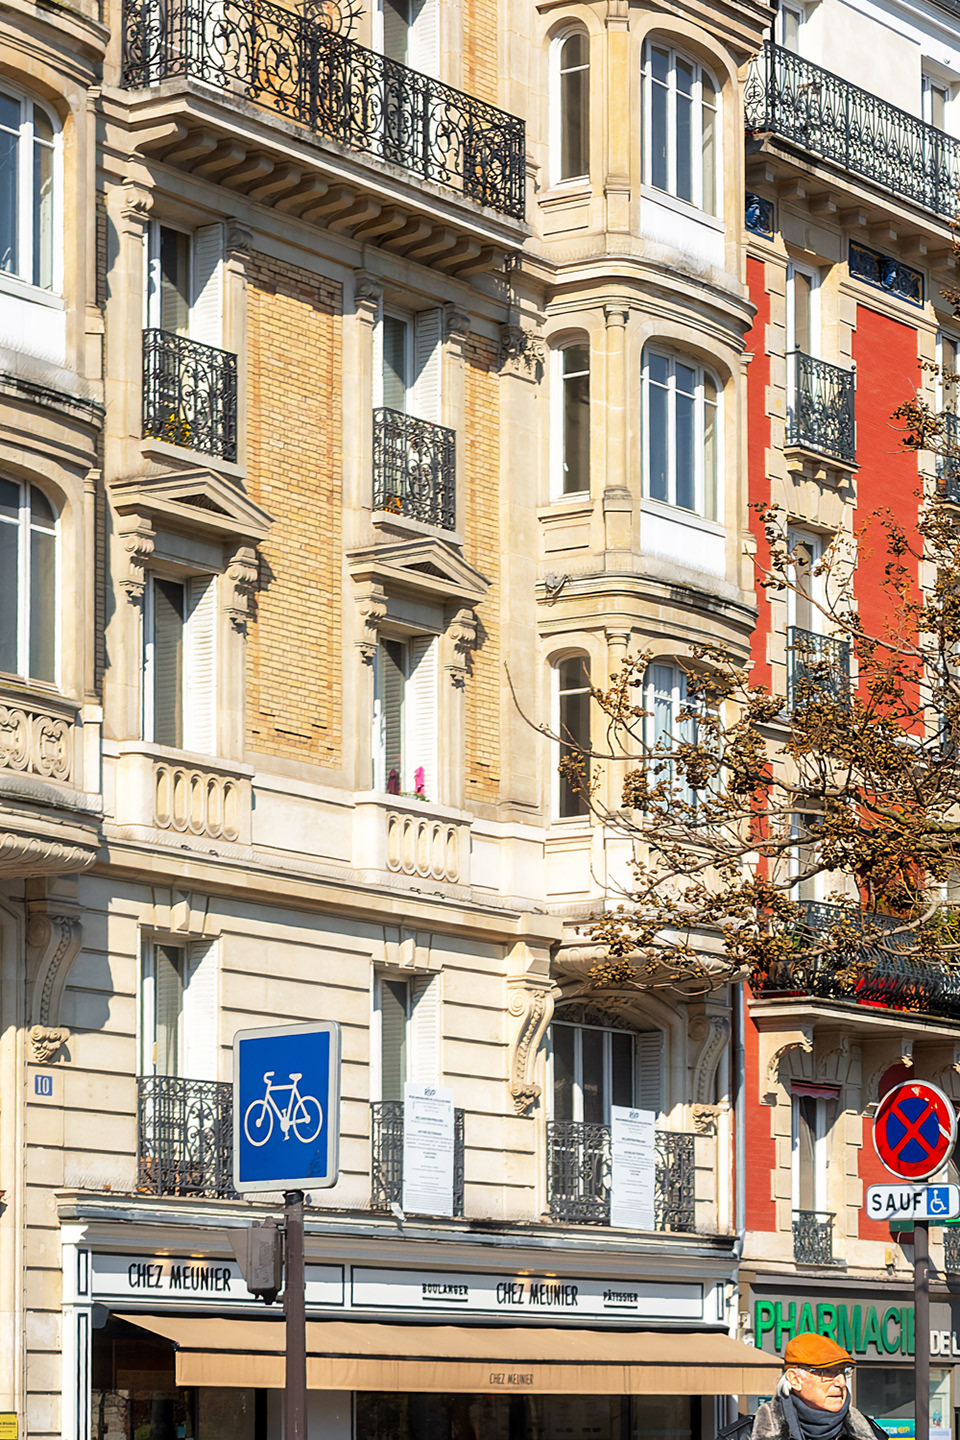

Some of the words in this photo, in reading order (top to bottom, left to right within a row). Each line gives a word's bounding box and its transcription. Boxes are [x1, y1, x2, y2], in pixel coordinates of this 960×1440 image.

[36, 1077, 50, 1094] 10
[872, 1193, 923, 1211] SAUF
[128, 1263, 163, 1288] CHEZ
[169, 1265, 231, 1292] MEUNIER
[422, 1283, 468, 1295] BOULANGER
[496, 1282, 524, 1305] CHEZ
[529, 1283, 578, 1306] MEUNIER
[930, 1330, 950, 1355] DE
[489, 1373, 505, 1384] CHEZ
[508, 1374, 533, 1385] MEUNIER
